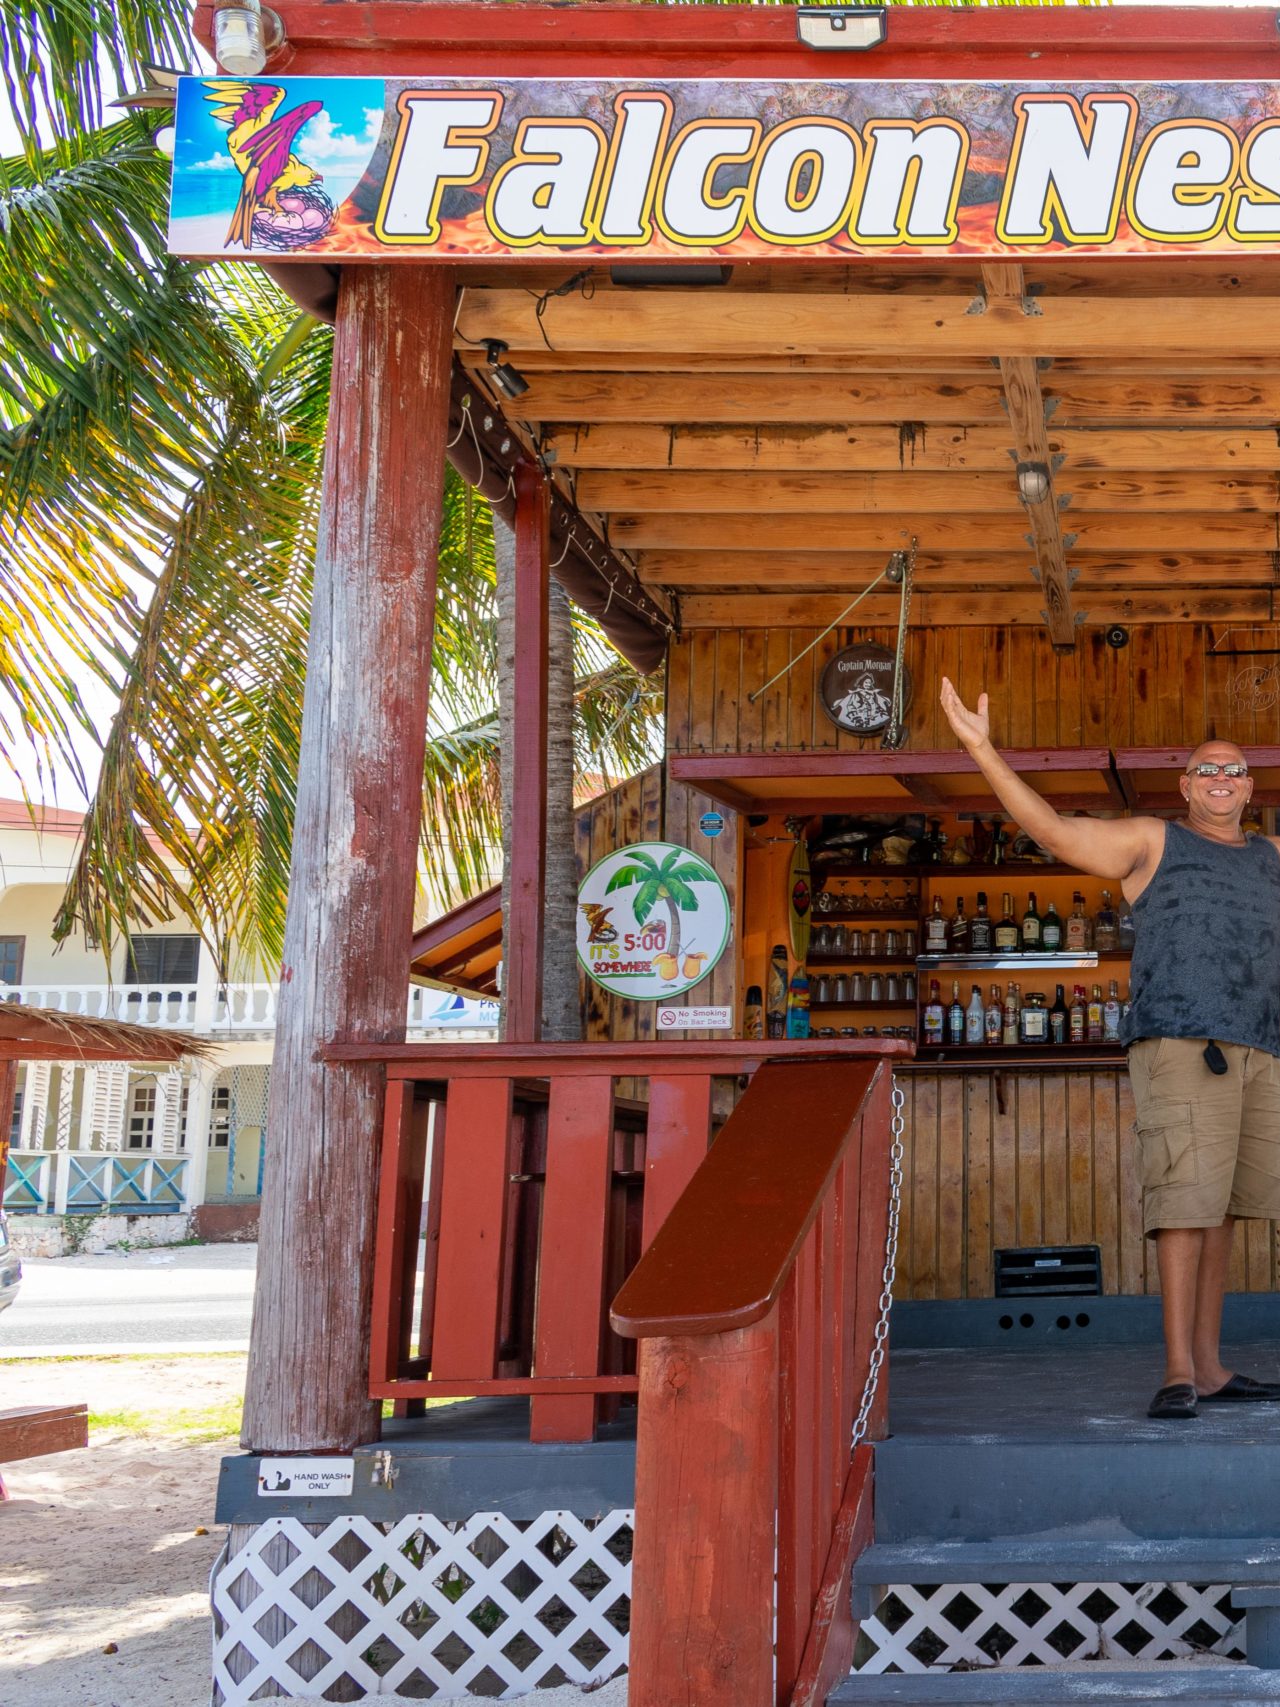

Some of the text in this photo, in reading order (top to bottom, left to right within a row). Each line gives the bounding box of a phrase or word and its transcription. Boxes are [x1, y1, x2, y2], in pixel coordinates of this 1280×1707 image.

[376, 91, 968, 245] Falcon
[838, 659, 892, 672] Captain Morgan
[590, 933, 666, 960] IT'S 5:00
[593, 960, 652, 974] SOMEWHERE
[693, 1010, 727, 1018] Smoking
[321, 1472, 347, 1480] WASH
[308, 1482, 330, 1490] ONLY
